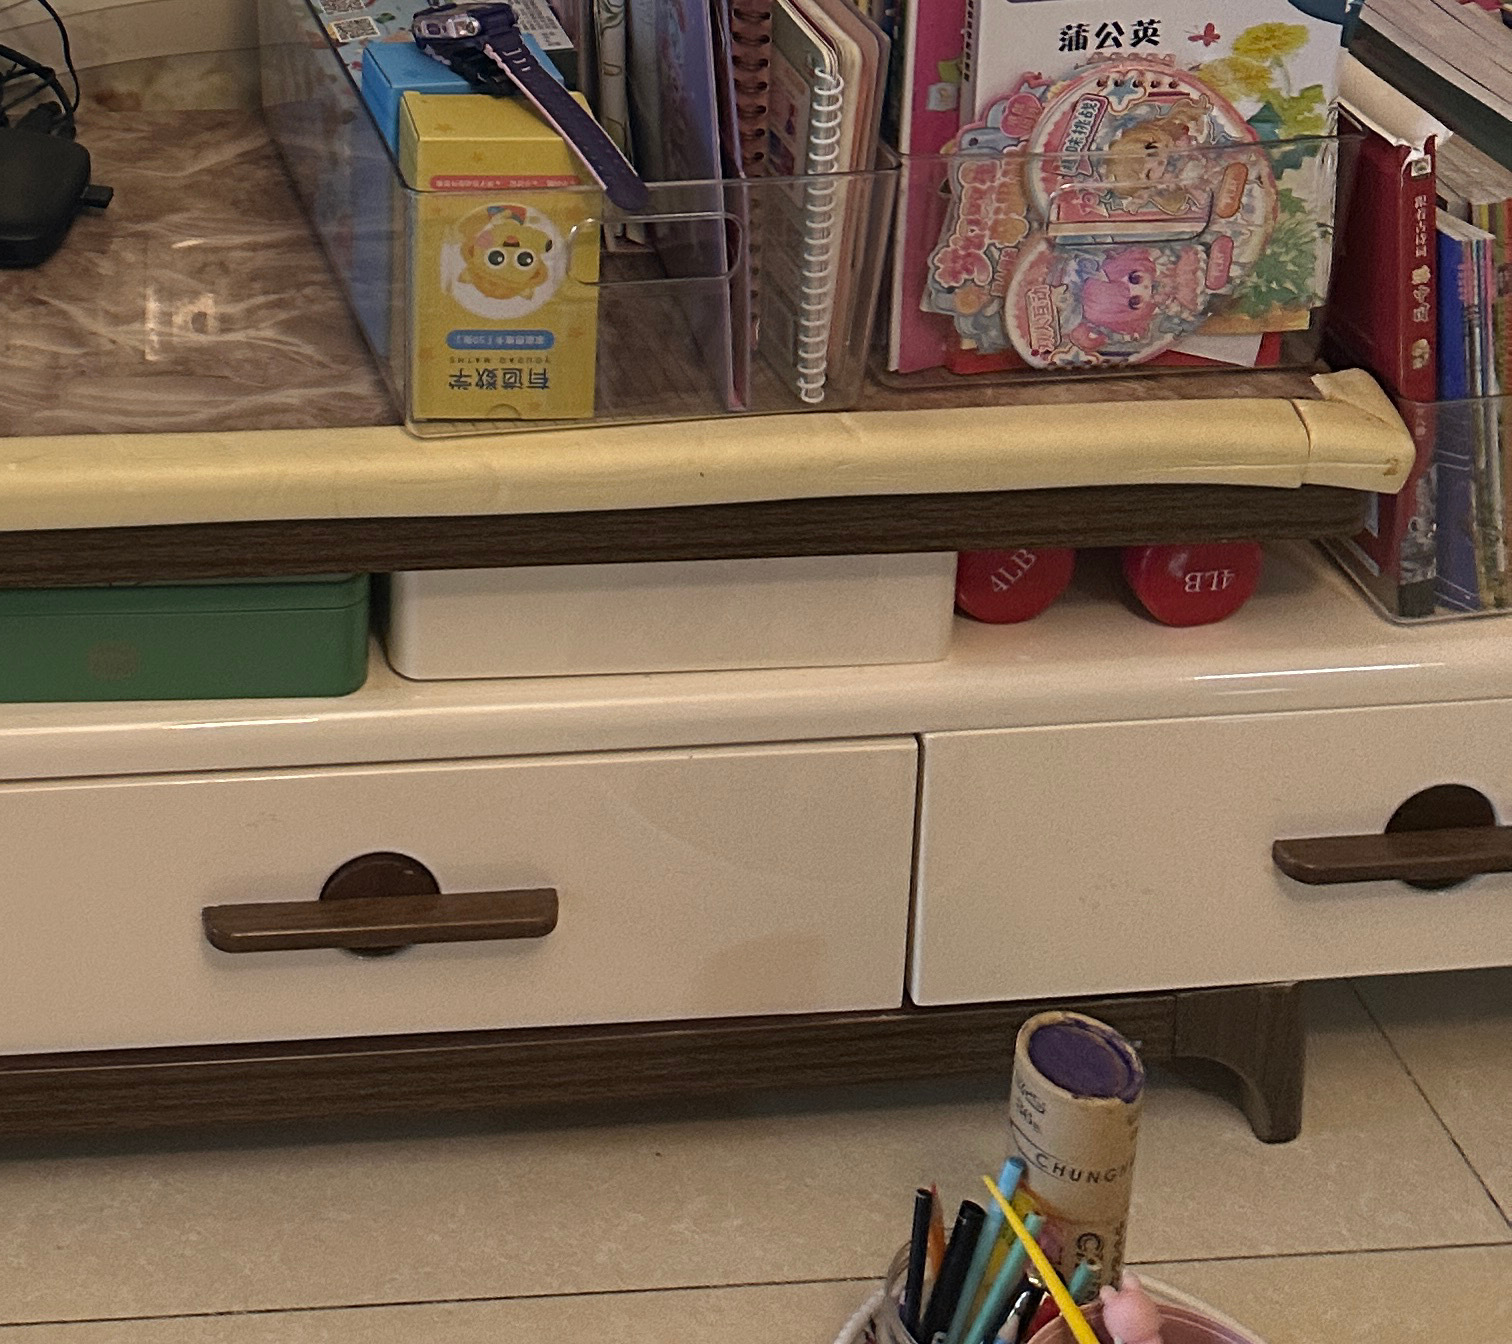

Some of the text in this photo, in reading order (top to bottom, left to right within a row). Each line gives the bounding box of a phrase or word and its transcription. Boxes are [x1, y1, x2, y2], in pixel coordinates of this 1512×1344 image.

[1058, 18, 1162, 52] 蒲公英
[448, 367, 550, 391] 有道数学
[989, 548, 1037, 594] 4LB
[1184, 568, 1236, 593] 4LB
